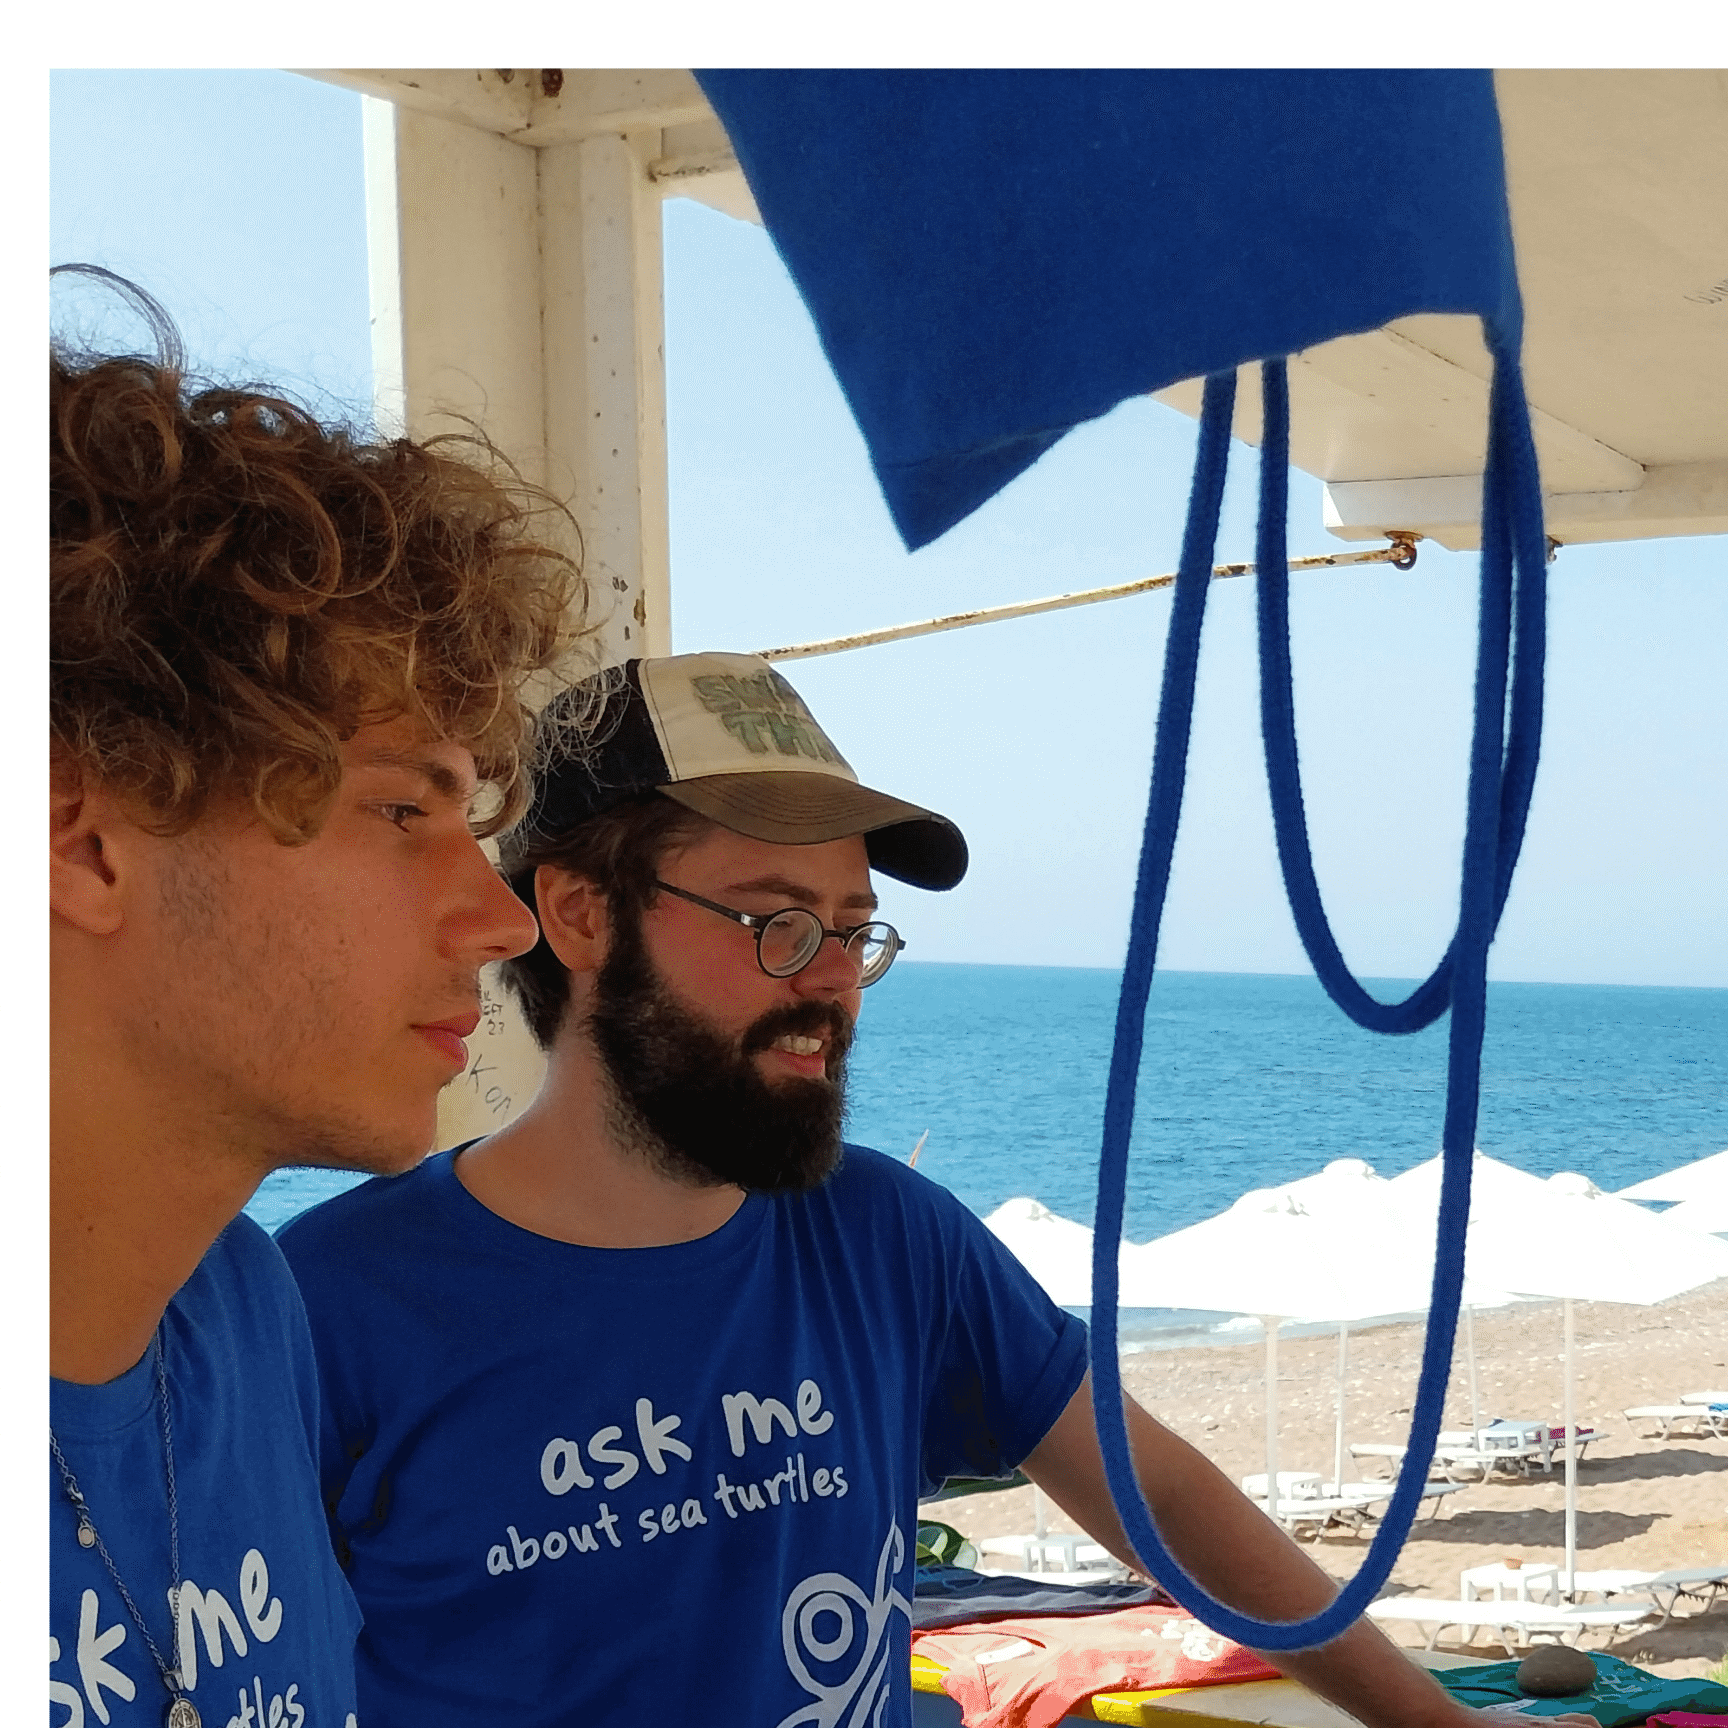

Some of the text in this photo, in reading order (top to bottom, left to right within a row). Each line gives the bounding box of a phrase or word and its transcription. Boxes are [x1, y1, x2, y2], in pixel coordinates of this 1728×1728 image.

[540, 1379, 834, 1496] ask me
[487, 1453, 848, 1575] about sea turtles
[167, 1548, 283, 1692] me
